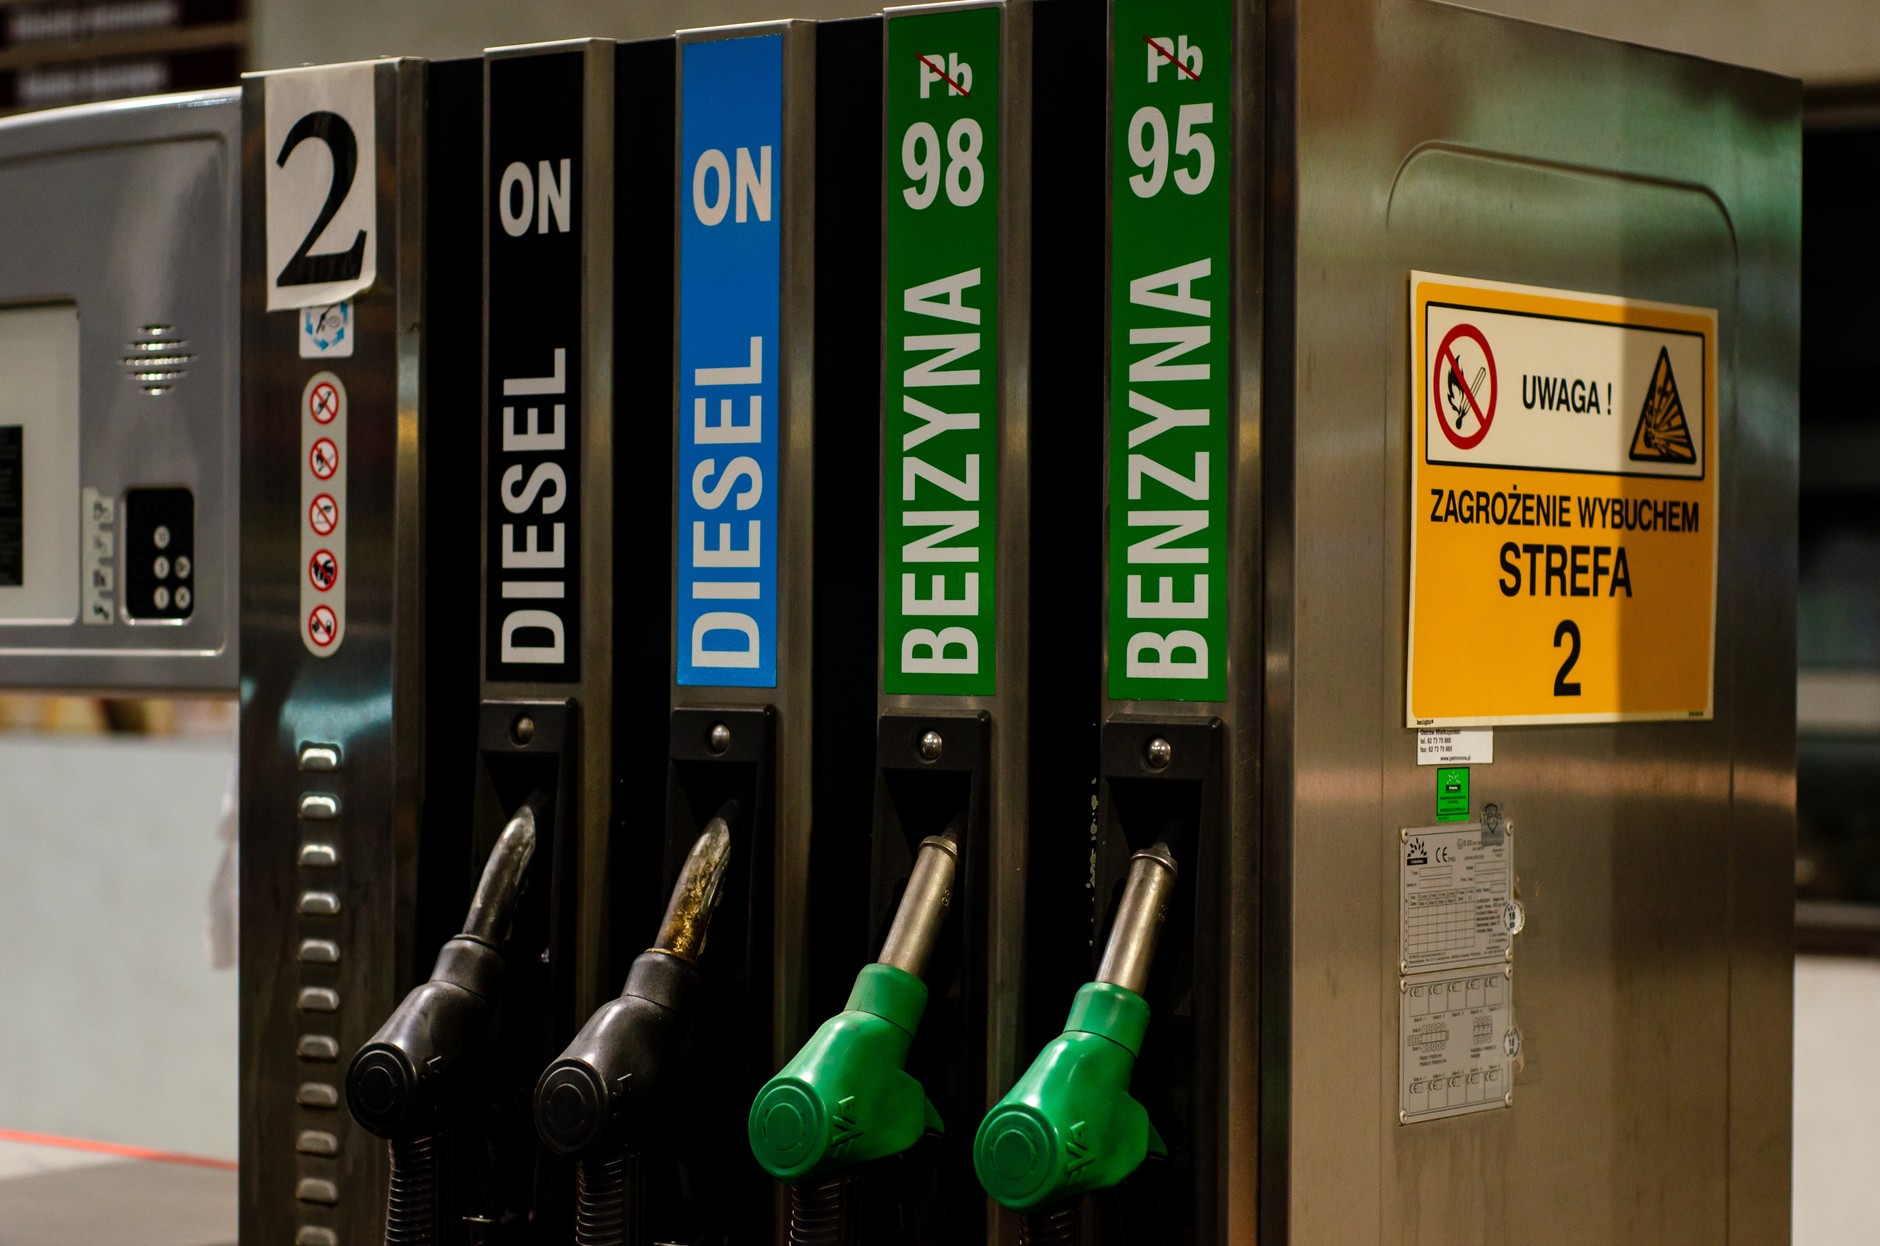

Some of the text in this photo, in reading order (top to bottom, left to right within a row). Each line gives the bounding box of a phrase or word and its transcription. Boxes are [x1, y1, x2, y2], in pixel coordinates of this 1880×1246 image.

[919, 53, 973, 98] Pb
[1148, 36, 1203, 83] Pb
[694, 145, 772, 226] ON
[902, 118, 984, 210] 98
[1128, 102, 1215, 199] 95
[277, 110, 367, 288] 2
[500, 159, 571, 237] ON
[1522, 375, 1600, 415] UWAGA
[502, 348, 566, 664] DIESEL
[691, 336, 763, 669] DIESEL
[902, 268, 981, 675] BENZYNA
[1127, 257, 1212, 680] BENZYNA
[1430, 485, 1700, 533] ZAGROŻENIE WYBUCHEM
[1499, 542, 1633, 598] STREFA
[1553, 619, 1581, 697] 2
